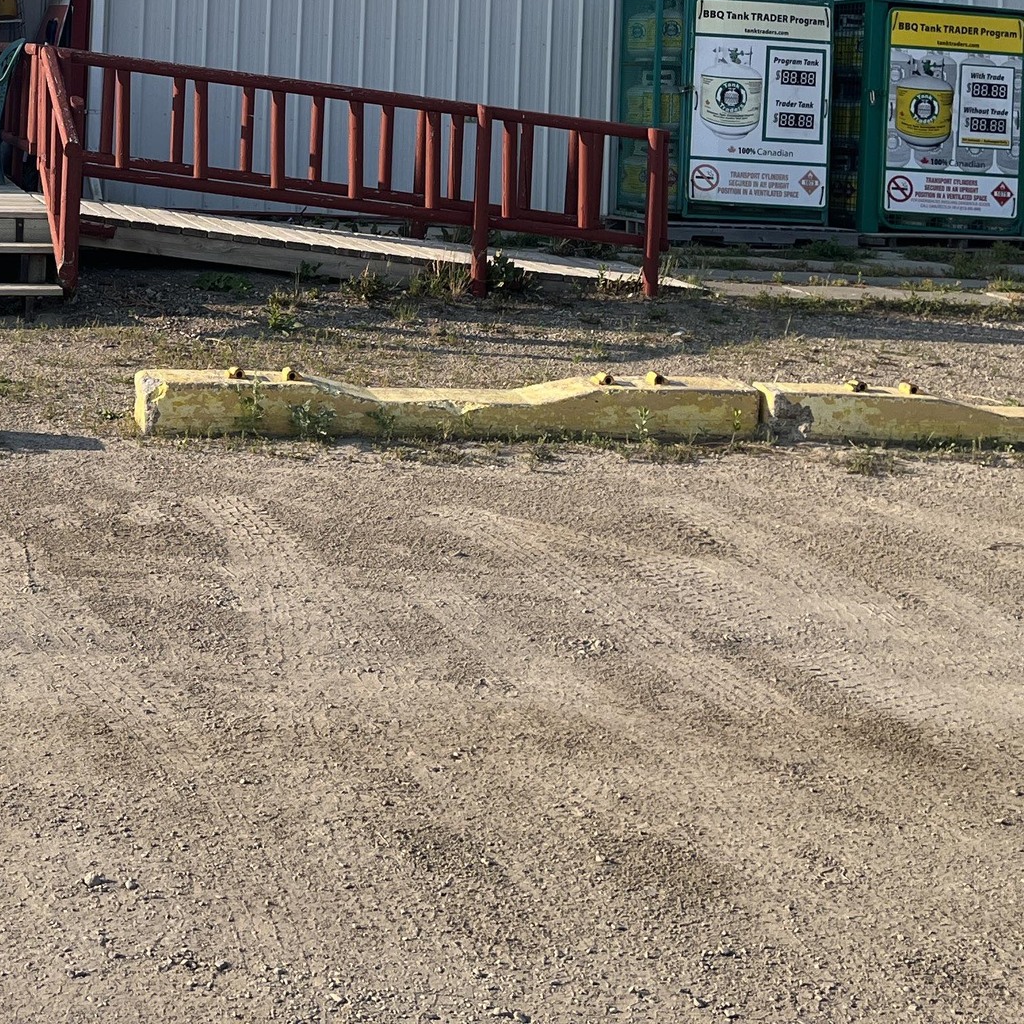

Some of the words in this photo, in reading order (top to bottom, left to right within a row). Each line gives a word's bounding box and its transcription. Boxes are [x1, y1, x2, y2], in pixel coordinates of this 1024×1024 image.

[702, 9, 724, 20] BBQ
[726, 11, 750, 21] Tank
[751, 12, 789, 24] TRADER
[790, 16, 826, 27] Program
[744, 28, 790, 36] tanktraders.com
[898, 22, 918, 32] BBQ
[920, 24, 942, 33] Tank
[944, 24, 979, 35] TRADER
[980, 28, 1018, 39] Program
[936, 40, 980, 48] tanktraders.com
[774, 56, 802, 66] Program
[804, 58, 820, 66] Tank
[775, 100, 798, 108] Trader
[964, 106, 990, 115] Without
[738, 147, 756, 155] 100%
[756, 148, 794, 158] Canadian
[730, 171, 761, 179] TRANSPORT
[762, 173, 789, 181] CYLINDERS
[926, 176, 952, 184] TRANSPORT
[728, 180, 752, 188] SECURED
[718, 187, 742, 196] POSITION
[754, 189, 783, 198] VENTILATED
